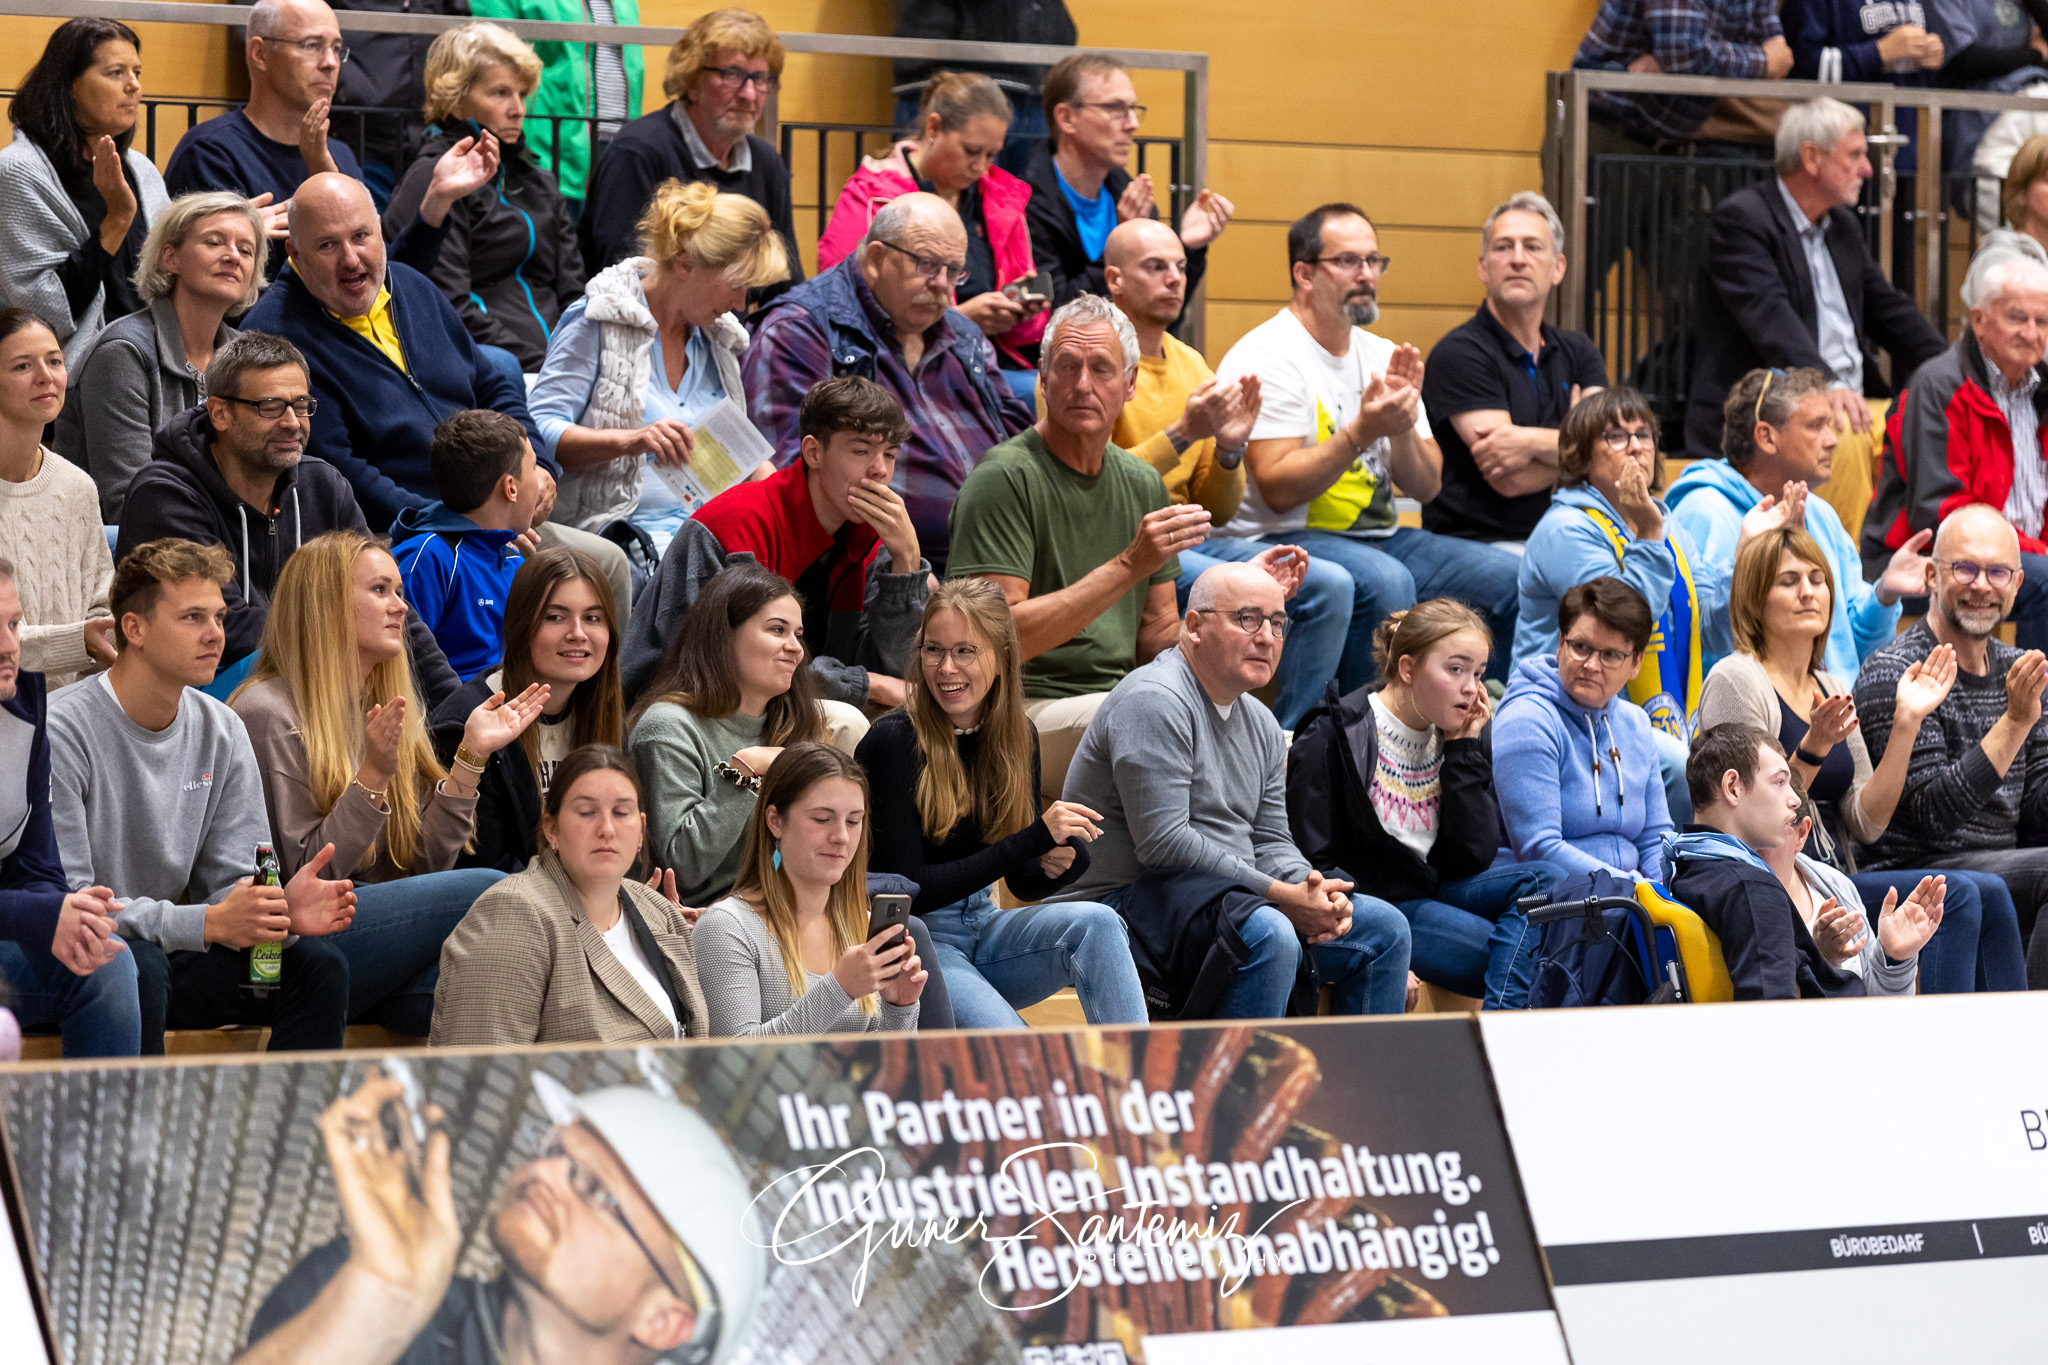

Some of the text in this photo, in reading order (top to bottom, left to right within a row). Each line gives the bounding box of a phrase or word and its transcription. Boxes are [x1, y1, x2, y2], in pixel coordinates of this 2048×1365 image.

[779, 1079, 1196, 1151] Ihr Partner in der
[2020, 1109, 2048, 1151] B
[1115, 1143, 1482, 1208] Instandhaltung.
[992, 1208, 1501, 1292] Herstellerunabhängig!
[1829, 1233, 1925, 1258] BÜROBEDARF
